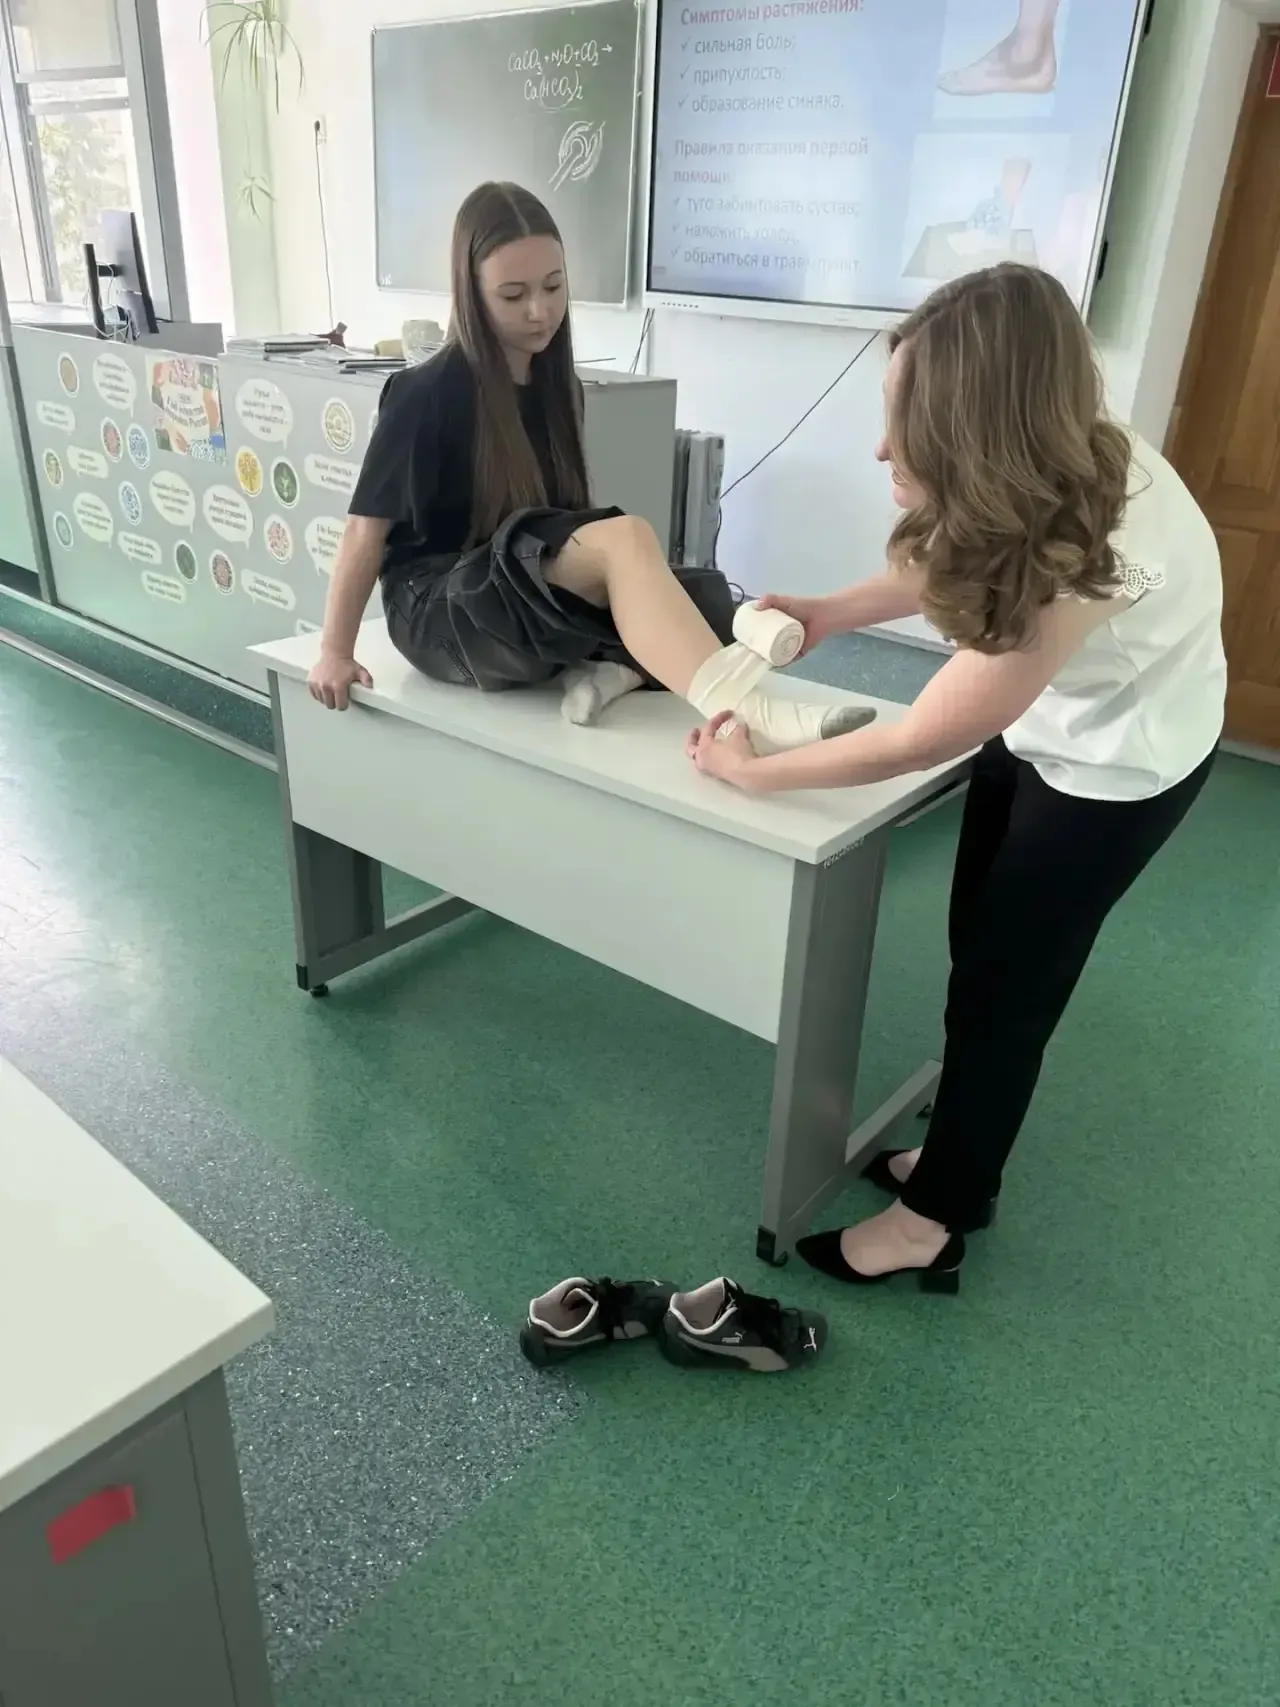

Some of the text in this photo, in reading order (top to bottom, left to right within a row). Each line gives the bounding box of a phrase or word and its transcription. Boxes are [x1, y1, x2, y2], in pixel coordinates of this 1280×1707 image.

[680, 0, 865, 26] Симптомы растяжения:
[694, 36, 752, 54] сильная
[692, 94, 785, 113] образование
[674, 139, 734, 159] Правила
[809, 136, 869, 158] первой
[687, 197, 713, 215] туго
[685, 223, 750, 241] наложить
[684, 246, 758, 270] обратиться
[762, 255, 770, 267] в
